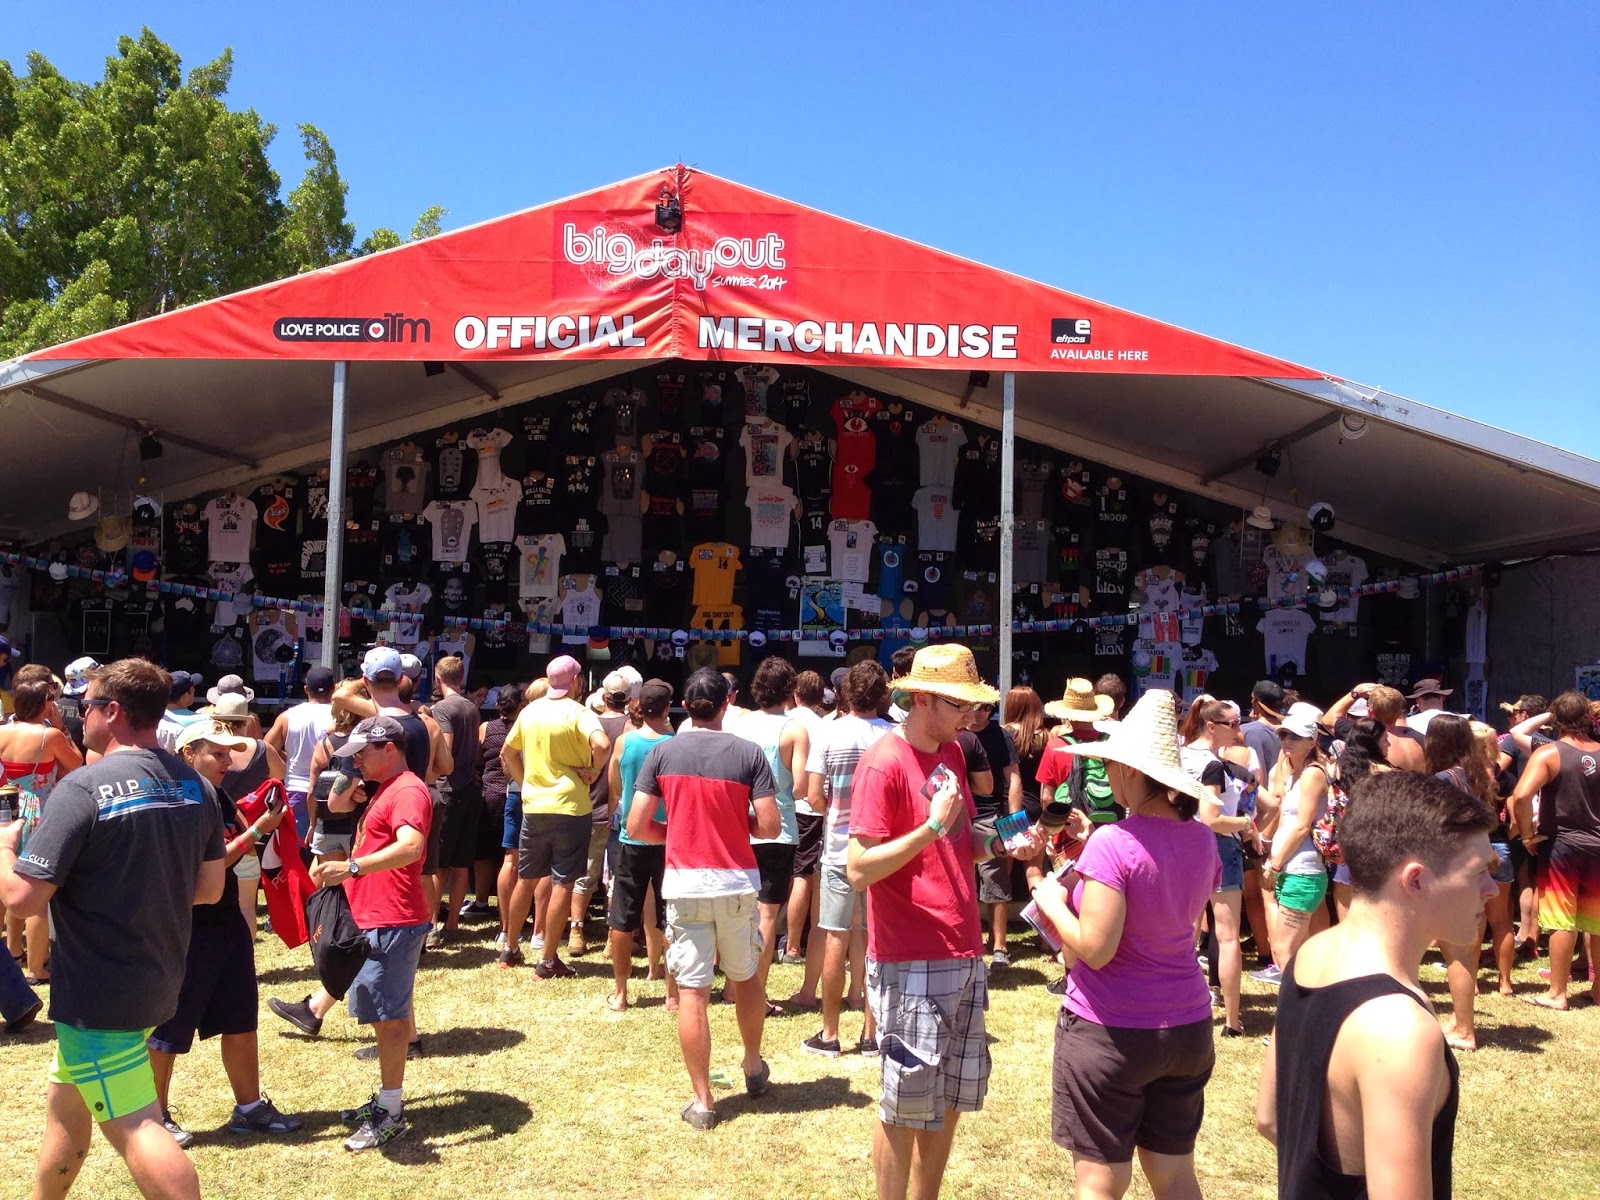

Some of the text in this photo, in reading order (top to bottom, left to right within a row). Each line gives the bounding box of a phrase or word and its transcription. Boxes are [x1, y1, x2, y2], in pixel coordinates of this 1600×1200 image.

[711, 274, 788, 291] SUMMER 2014
[280, 324, 360, 337] LOVE POLICE
[454, 315, 1019, 360] OFFICIAL MERCHANDISE
[1055, 334, 1087, 344] eftpos
[1050, 348, 1149, 362] AVAILABLE HERE
[810, 517, 822, 530] 14
[1099, 512, 1128, 523] SNOOP
[718, 558, 728, 570] 14
[1096, 561, 1127, 574] SNOOP
[1096, 576, 1124, 594] LION
[1095, 625, 1124, 634] SNOOP
[1094, 643, 1124, 656] LION
[1376, 654, 1411, 663] VIOLENT
[98, 780, 140, 799] RIP
